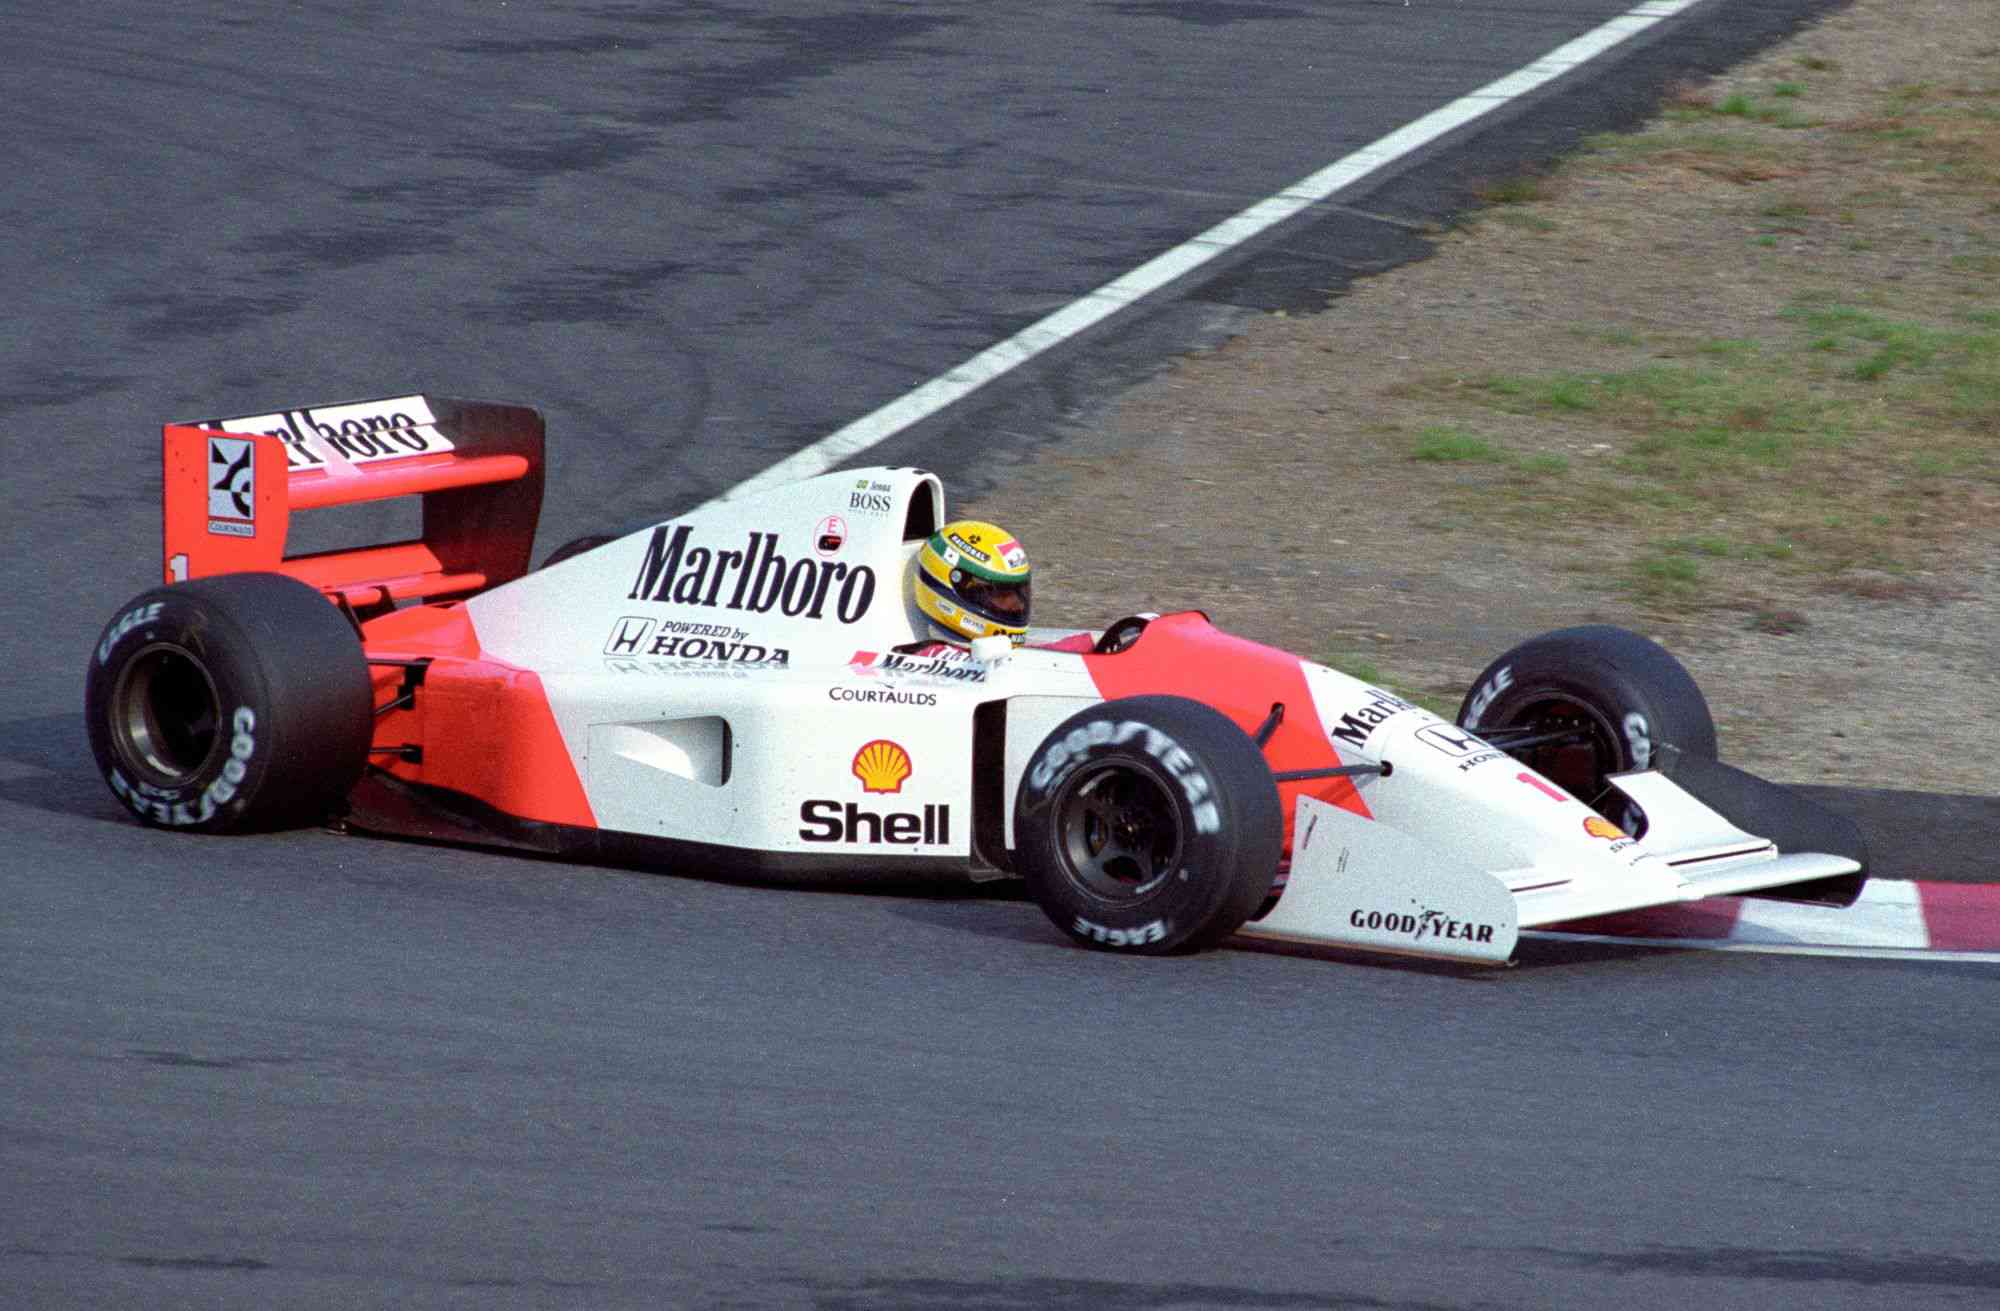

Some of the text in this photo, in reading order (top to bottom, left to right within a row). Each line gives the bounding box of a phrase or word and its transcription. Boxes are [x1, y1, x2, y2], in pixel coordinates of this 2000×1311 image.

[849, 492, 891, 512] BOSS
[628, 525, 876, 624] Marlboro
[661, 620, 751, 641] POWERED by
[648, 635, 790, 665] HONDA
[828, 687, 938, 706] COURTAULDS
[1031, 720, 1220, 834] GOODYEAR
[799, 800, 950, 845] Shell
[1072, 916, 1167, 946] EAGLE
